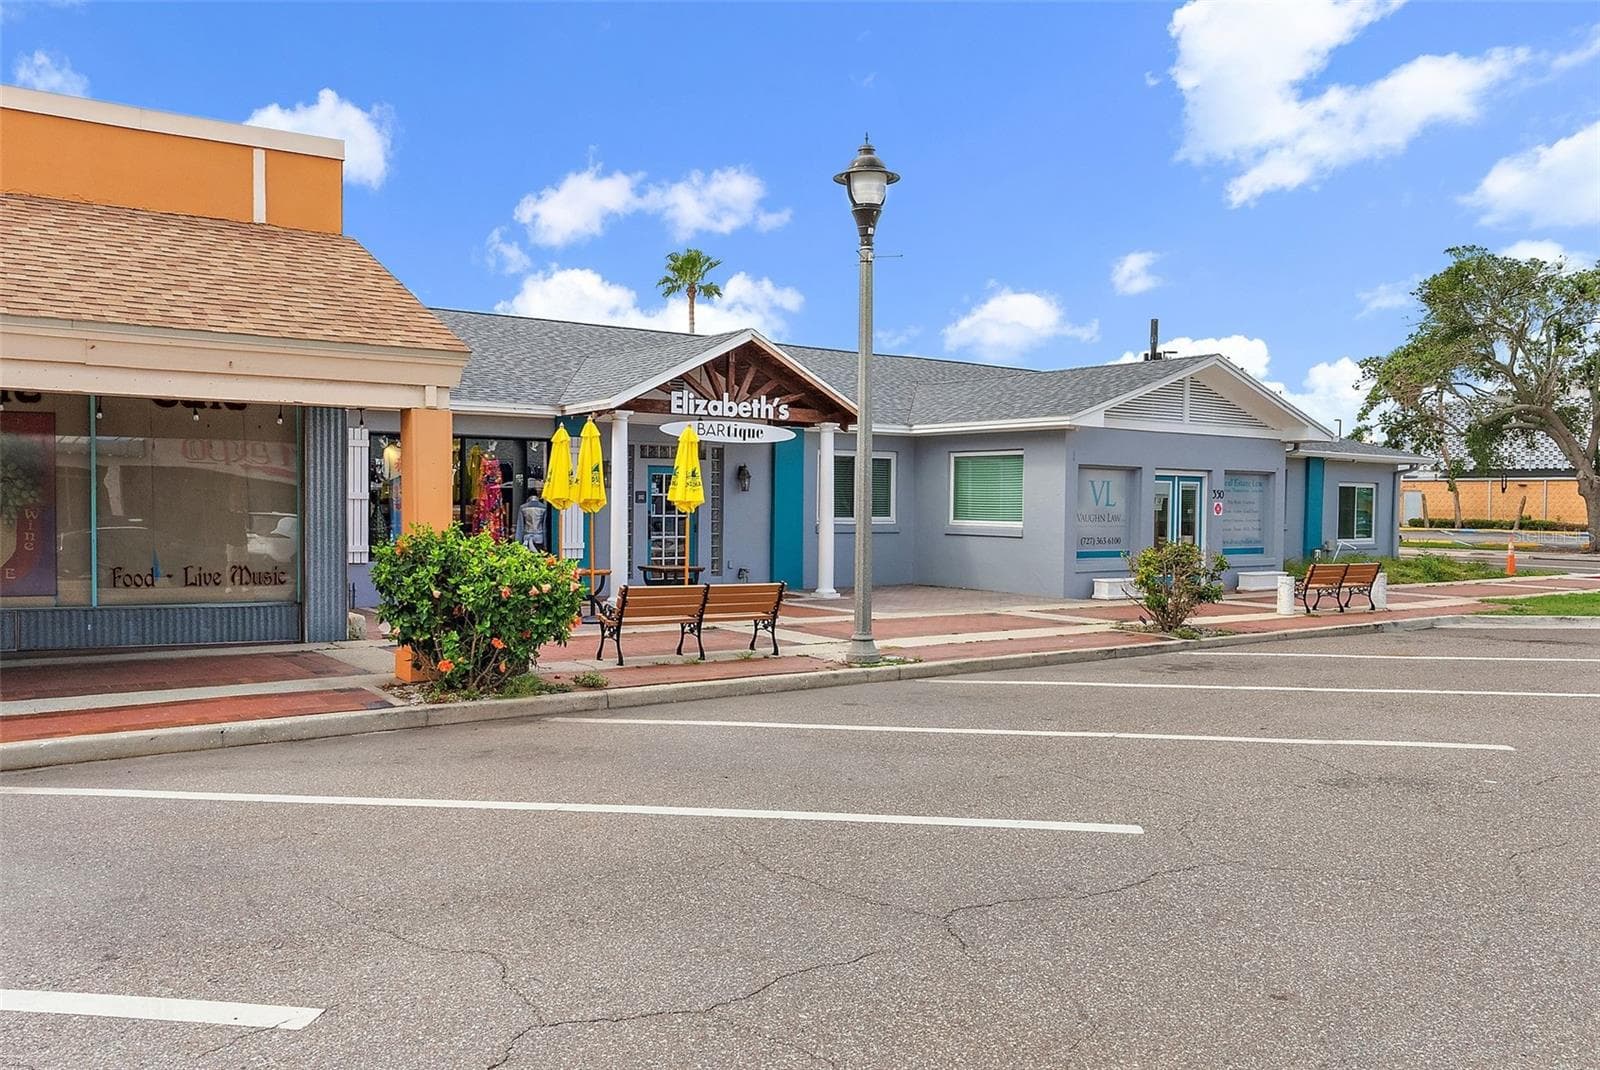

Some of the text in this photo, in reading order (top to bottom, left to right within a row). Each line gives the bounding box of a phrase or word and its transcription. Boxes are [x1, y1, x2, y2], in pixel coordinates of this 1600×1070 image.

[670, 389, 790, 420] Elizabeth's
[1088, 479, 1117, 507] VL
[1212, 489, 1225, 500] 350
[1080, 536, 1096, 546] (727)
[110, 566, 155, 588] Food
[183, 565, 222, 587] Live
[231, 565, 287, 586] Music
